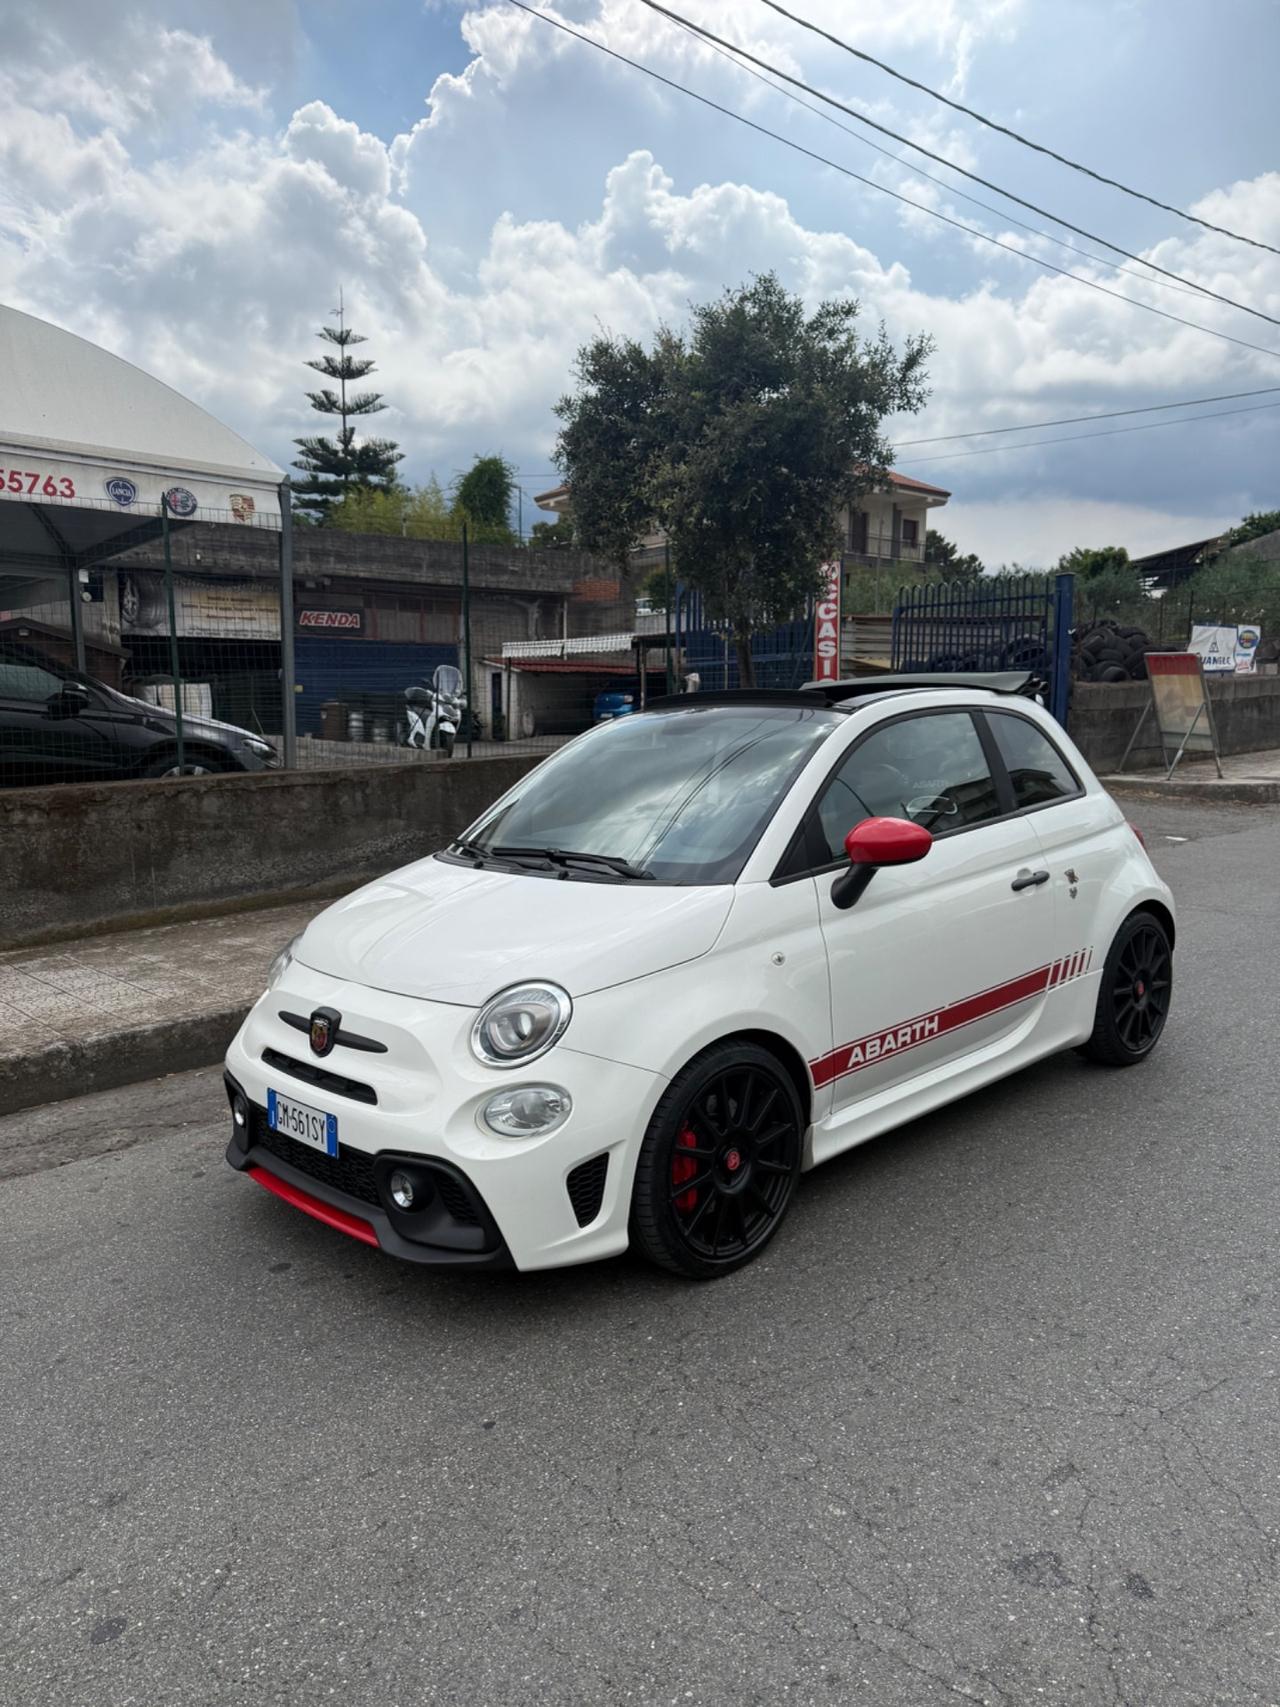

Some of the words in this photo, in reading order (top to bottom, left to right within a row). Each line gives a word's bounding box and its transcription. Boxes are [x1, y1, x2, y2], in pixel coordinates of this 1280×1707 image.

[299, 610, 360, 628] KENDA
[818, 561, 839, 682] CASI
[847, 1015, 939, 1068] ABARTH
